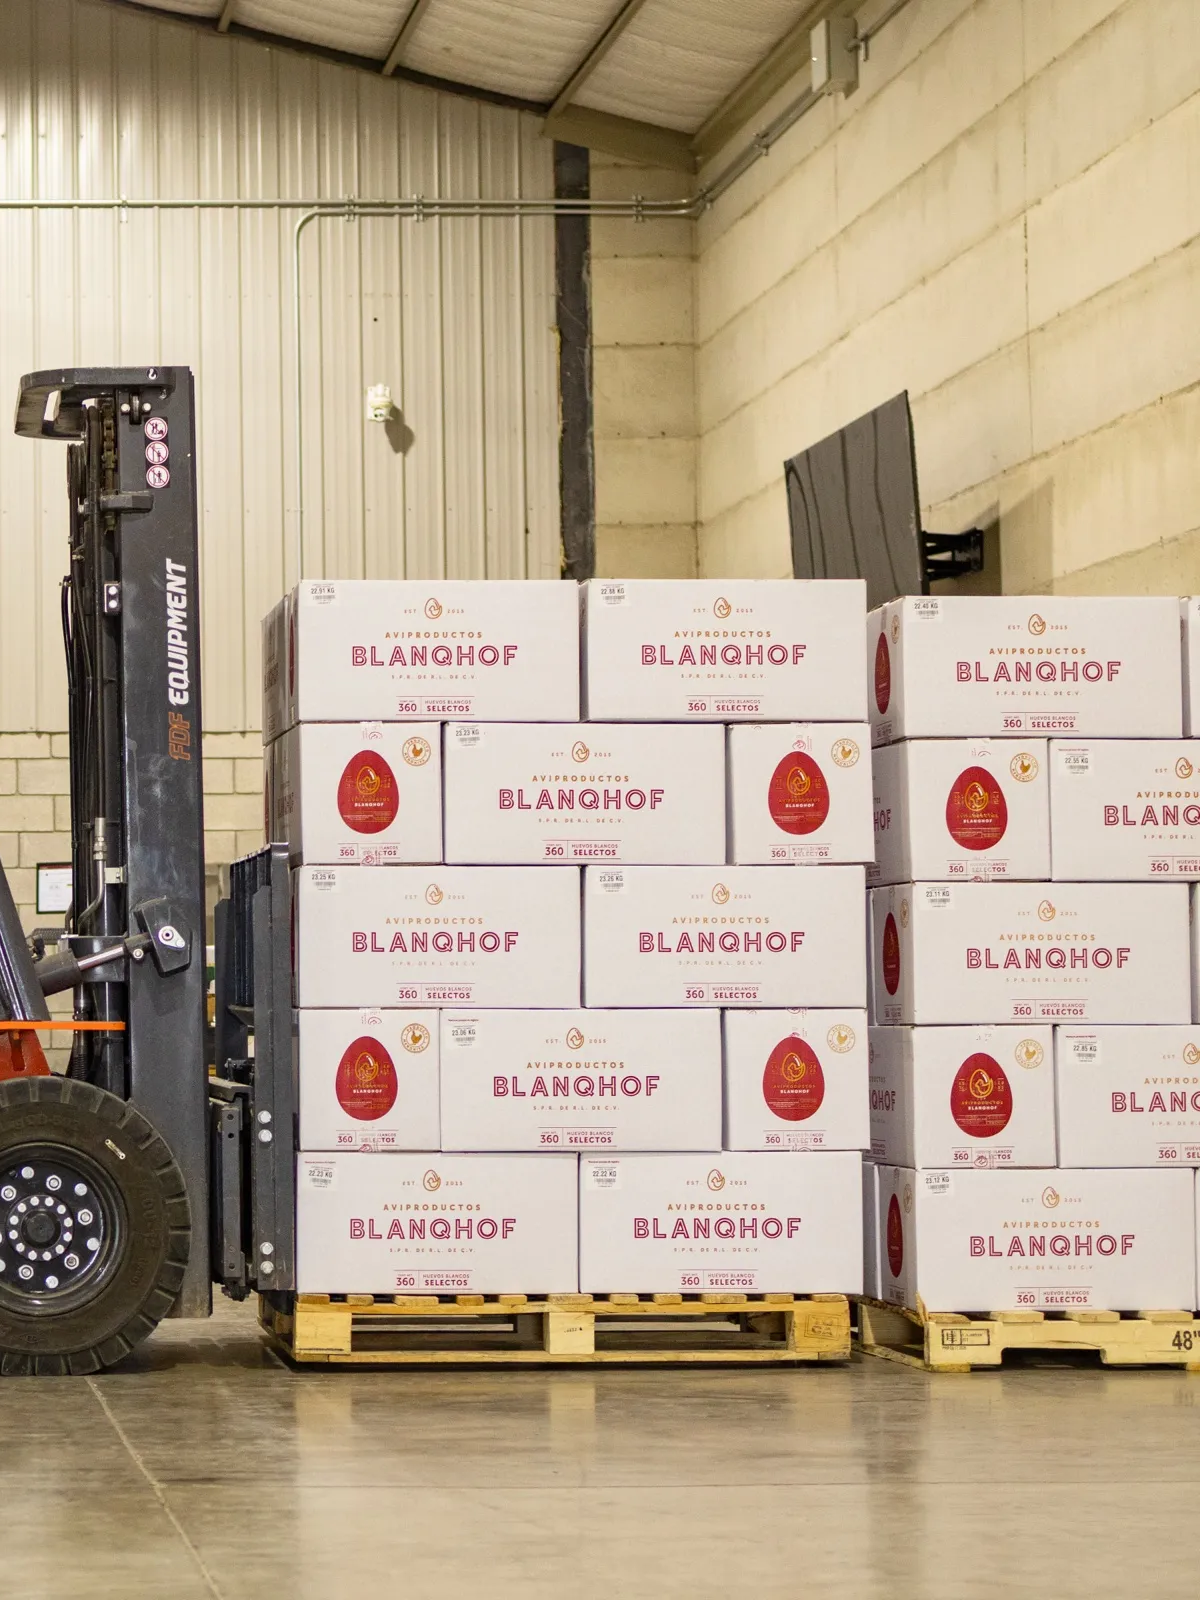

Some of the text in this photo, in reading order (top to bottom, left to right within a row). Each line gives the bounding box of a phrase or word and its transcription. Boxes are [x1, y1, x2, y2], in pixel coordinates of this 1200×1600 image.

[166, 558, 190, 760] FDF EQUIPMENT
[352, 645, 517, 666] BLANQHOF
[642, 644, 806, 665] BLANQHOF
[957, 661, 1121, 682] BLANQHOF
[398, 704, 417, 712] 360
[688, 703, 706, 711] 360
[1004, 719, 1022, 728] 360
[499, 788, 664, 810] BLANQHOF
[545, 847, 564, 856] 360
[1151, 863, 1169, 872] 360
[352, 931, 518, 953] BLANQHOF
[639, 932, 805, 953] BLANQHOF
[967, 948, 1131, 969] BLANQHOF
[399, 990, 417, 999] 360
[686, 990, 704, 999] 360
[1013, 1007, 1032, 1015] 360
[494, 1076, 660, 1097] BLANQHOF
[540, 1134, 559, 1143] 360
[1159, 1150, 1177, 1159] 360
[383, 1204, 481, 1212] AVIPRODUCTOS
[350, 1218, 516, 1240] BLANQHOF
[634, 1217, 801, 1239] BLANQHOF
[1003, 1221, 1100, 1229] AVIPRODUCTOS
[970, 1235, 1135, 1257] BLANQHOF
[396, 1277, 415, 1286] 360
[681, 1277, 700, 1285] 360
[1017, 1294, 1035, 1303] 360
